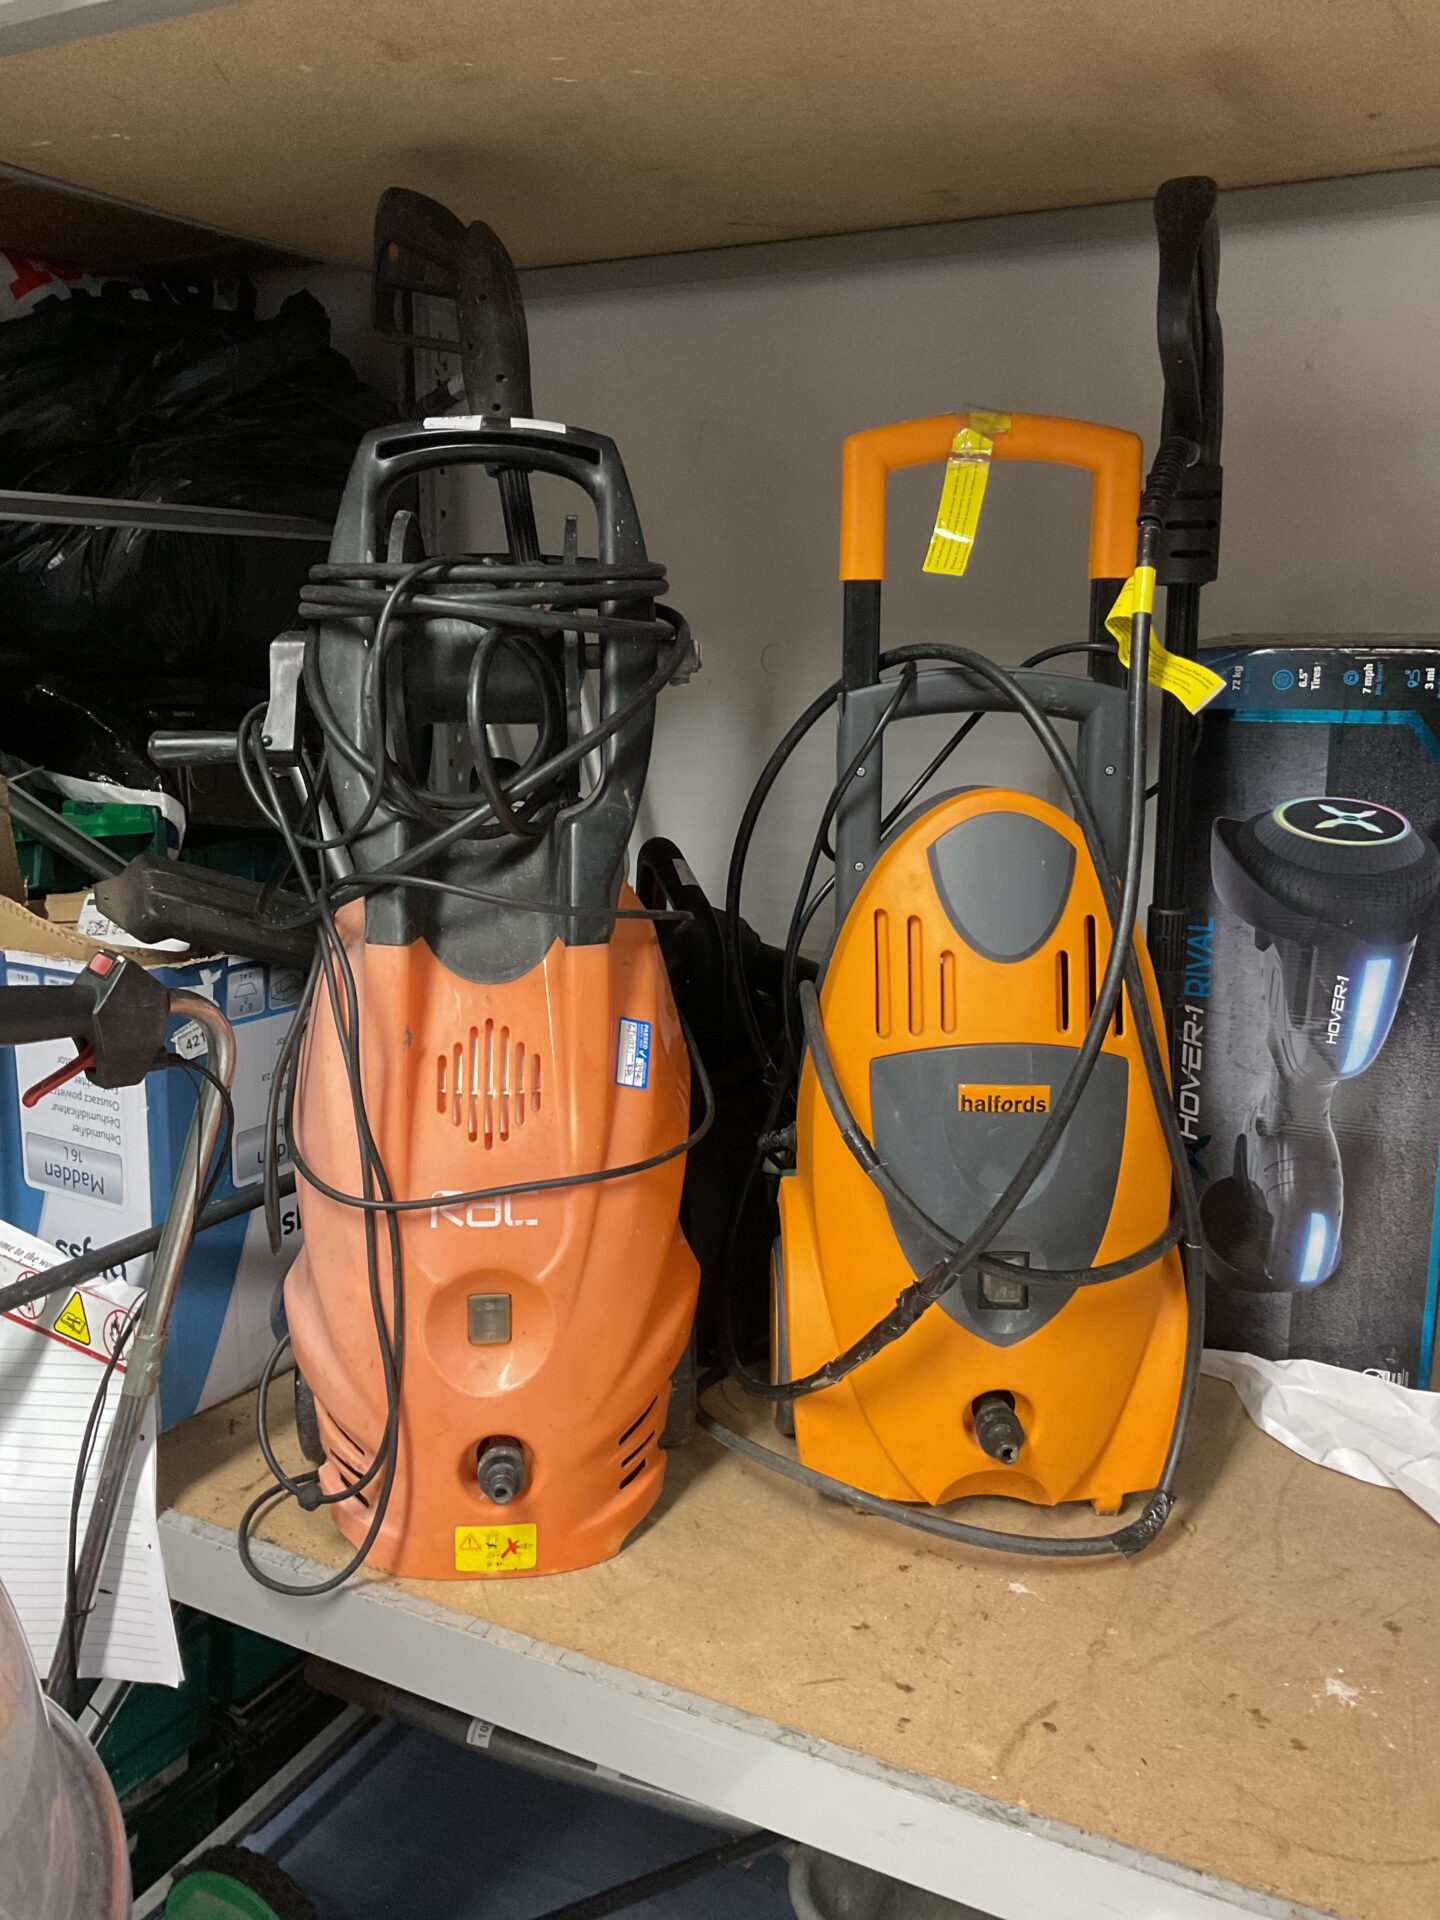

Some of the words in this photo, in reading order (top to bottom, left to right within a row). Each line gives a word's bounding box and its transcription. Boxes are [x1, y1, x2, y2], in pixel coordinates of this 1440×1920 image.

[1233, 665, 1244, 678] kg
[1310, 666, 1322, 690] Tires
[1363, 663, 1374, 686] mph
[1425, 667, 1435, 681] mi
[1232, 679, 1241, 691] 72
[1424, 682, 1434, 690] 3
[1184, 917, 1215, 998] RIVAL
[1326, 975, 1350, 1045] HOVER-1
[642, 1024, 650, 1050] PASSED
[1179, 1004, 1205, 1140] HOVER-1
[84, 1093, 120, 1111] Osuszacz
[961, 1095, 1047, 1113] halfords
[72, 1124, 121, 1146] Dehumidifier
[64, 1146, 69, 1156] L
[72, 1148, 83, 1163] 16
[44, 1161, 104, 1196] Madden
[14, 1247, 25, 1256] to
[23, 1251, 40, 1263] the
